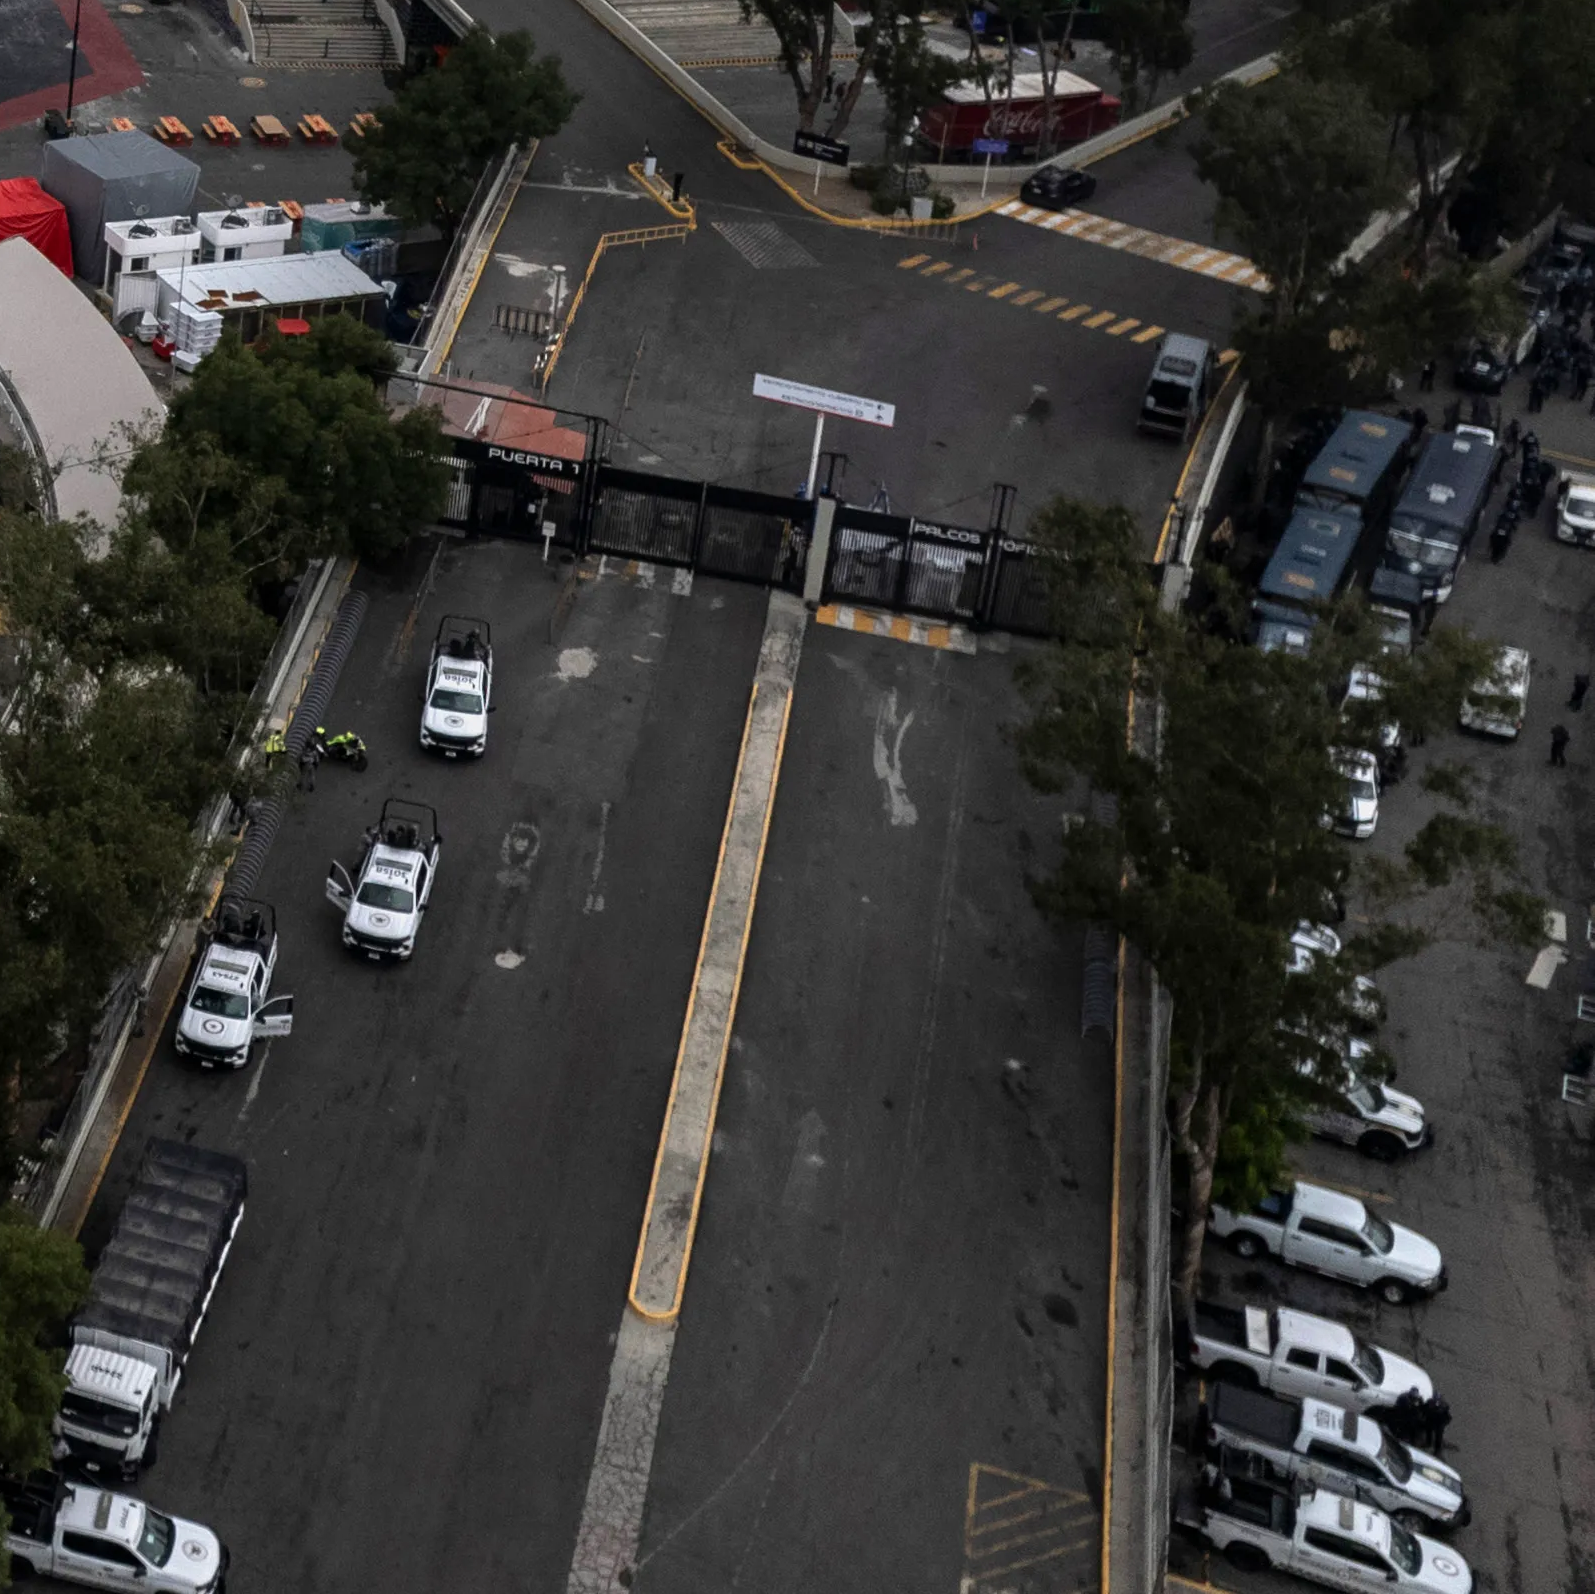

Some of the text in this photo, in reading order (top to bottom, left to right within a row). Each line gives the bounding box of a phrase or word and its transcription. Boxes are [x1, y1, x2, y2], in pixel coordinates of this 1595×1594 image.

[489, 447, 579, 475] PUERTA 1
[914, 522, 981, 545] PALCOS
